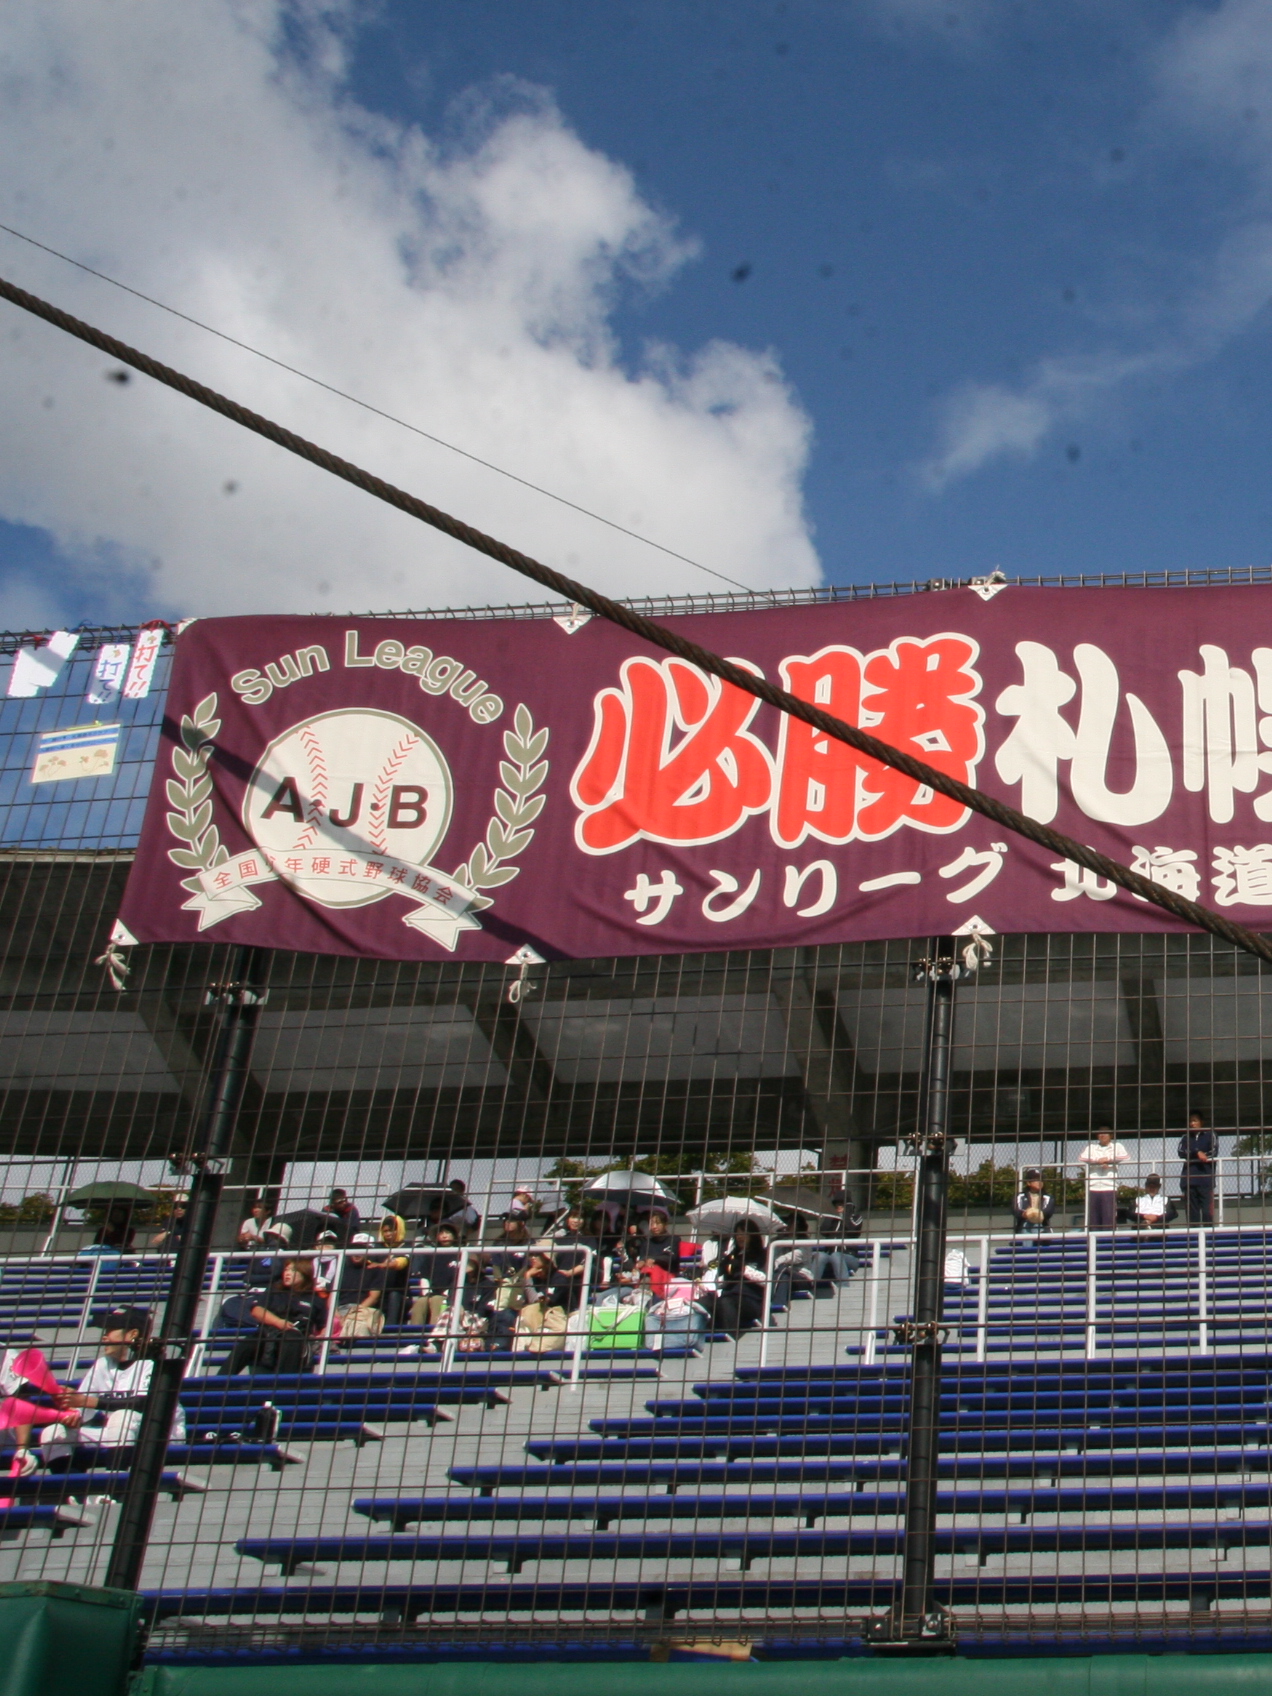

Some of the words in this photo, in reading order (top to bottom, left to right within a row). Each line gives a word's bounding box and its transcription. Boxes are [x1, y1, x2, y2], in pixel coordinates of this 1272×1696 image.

[231, 644, 331, 705] Sun
[344, 630, 504, 725] League
[569, 632, 986, 856] 必勝
[623, 842, 1009, 926] サンリーグ
